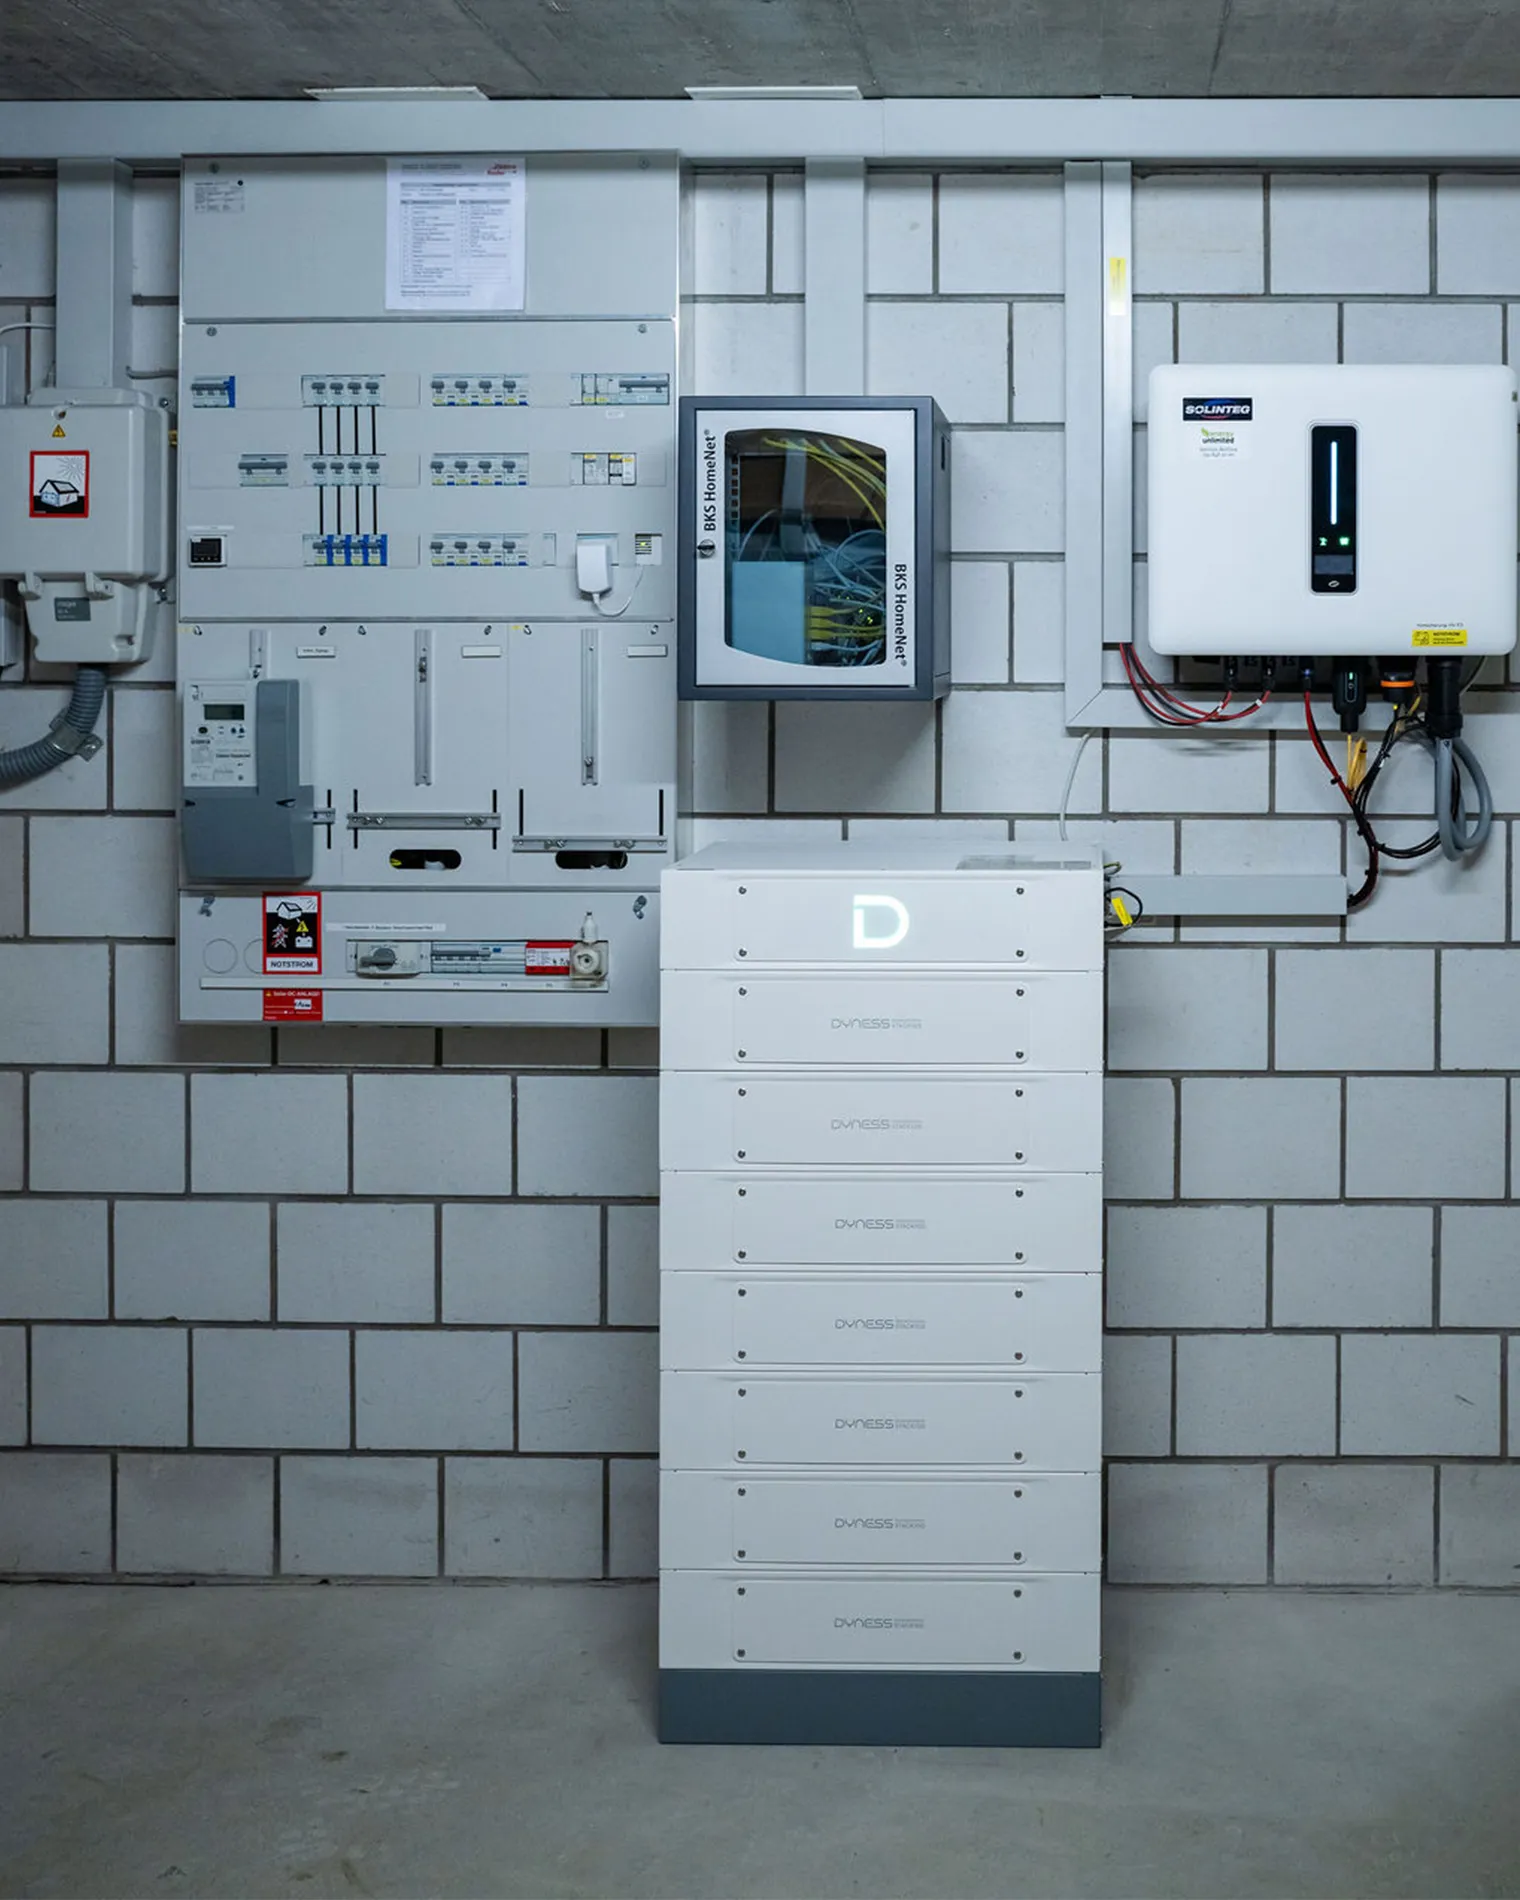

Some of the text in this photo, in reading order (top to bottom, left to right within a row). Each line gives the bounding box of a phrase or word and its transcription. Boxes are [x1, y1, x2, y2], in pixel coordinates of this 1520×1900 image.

[1185, 405, 1251, 414] SOLINTEG
[704, 504, 717, 531] BKS
[894, 563, 908, 590] BKS
[853, 894, 909, 949] D
[270, 960, 314, 968] NOTSTROM
[831, 1018, 890, 1029] DYNESS
[831, 1119, 890, 1130] DYNESS
[834, 1218, 894, 1229] DYNESS
[834, 1318, 894, 1329] DYNESS
[834, 1418, 894, 1429] DYNESS
[834, 1518, 894, 1529] DYNESS
[833, 1618, 893, 1629] DYNESS
